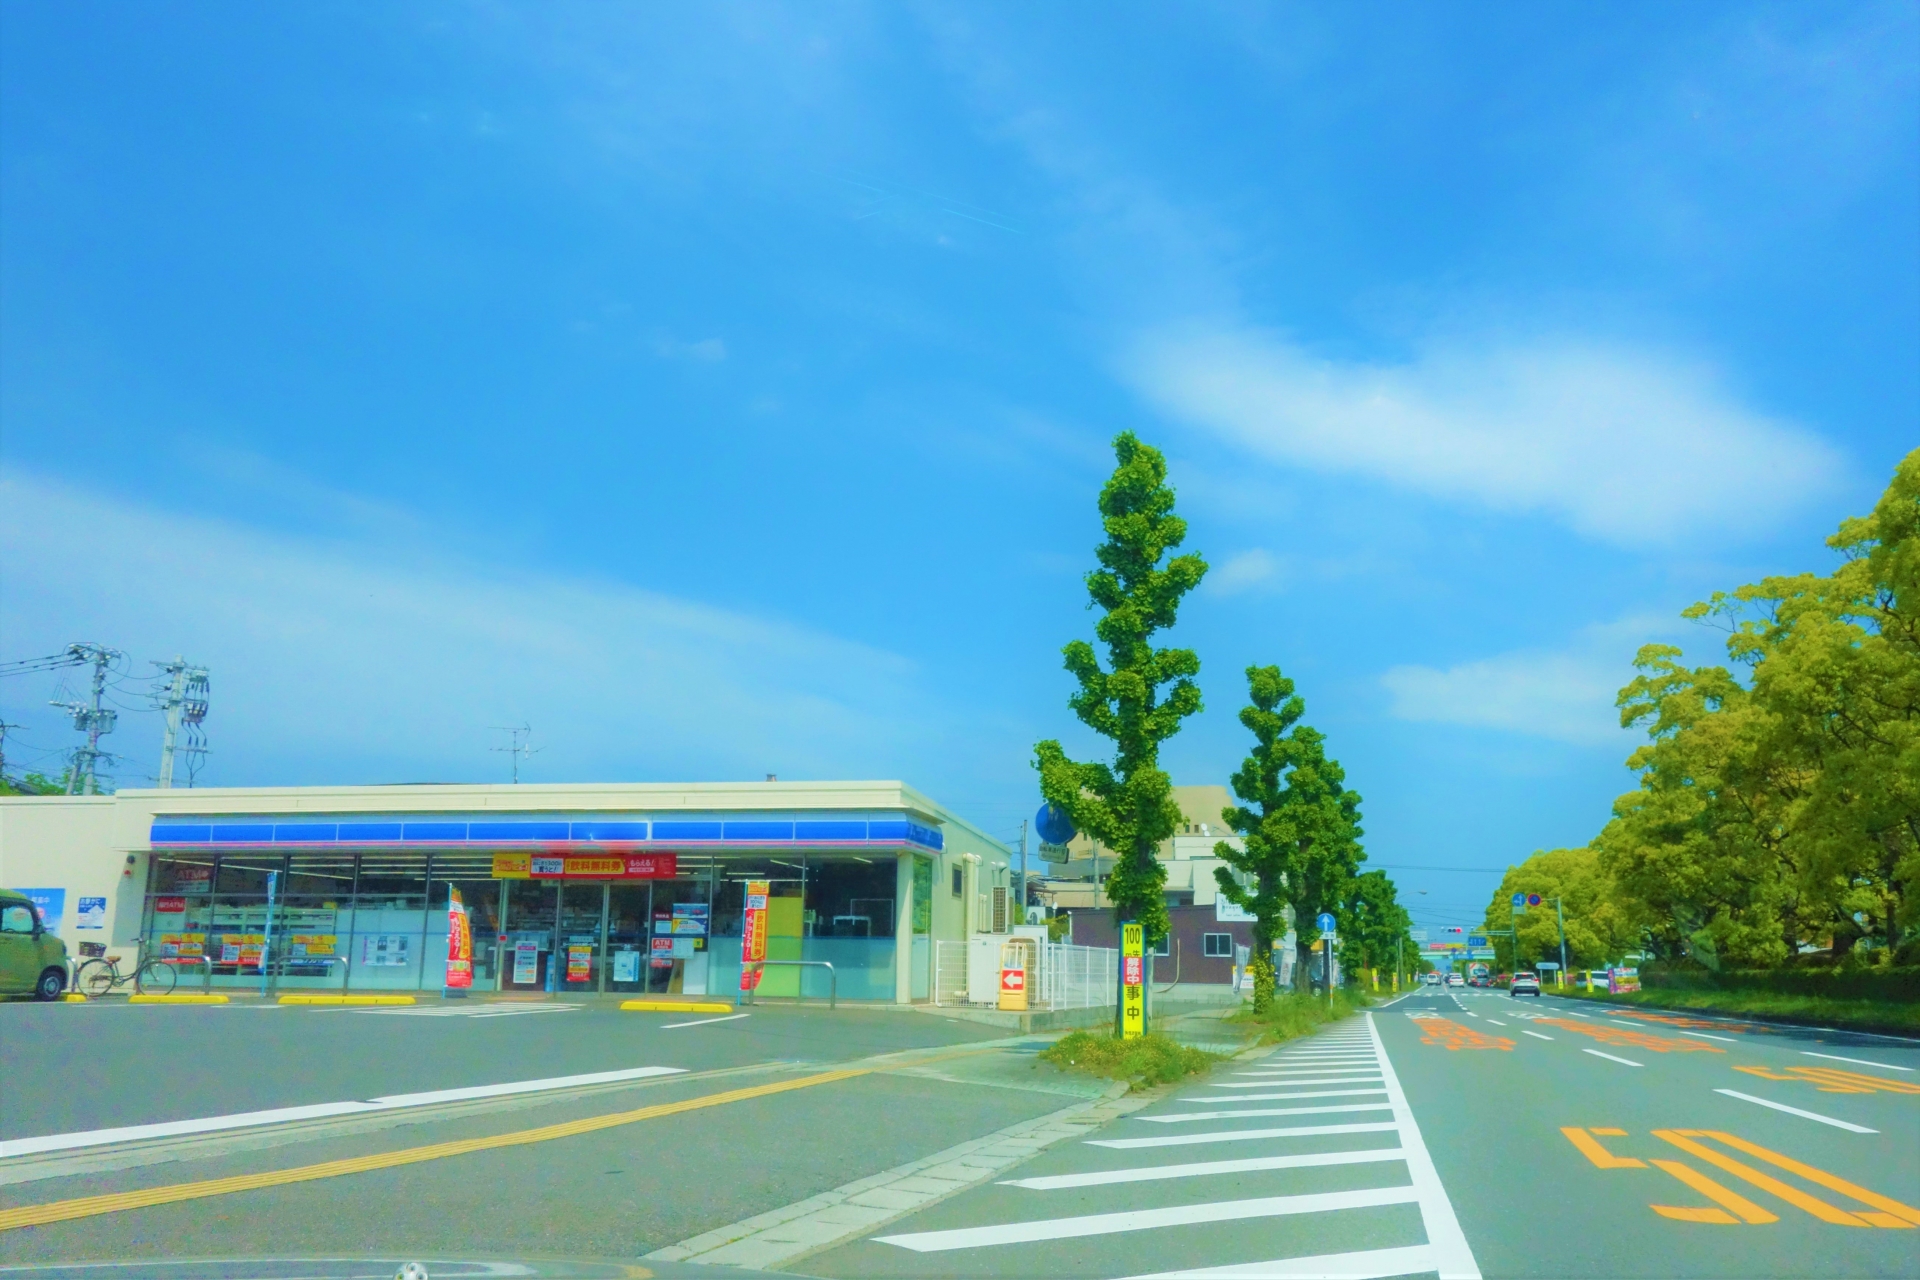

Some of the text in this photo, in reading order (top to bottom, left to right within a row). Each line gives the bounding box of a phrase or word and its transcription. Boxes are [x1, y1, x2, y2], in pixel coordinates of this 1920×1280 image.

[1125, 928, 1141, 944] 100
[1126, 957, 1140, 984] 解除中
[1560, 1127, 1920, 1229] 50
